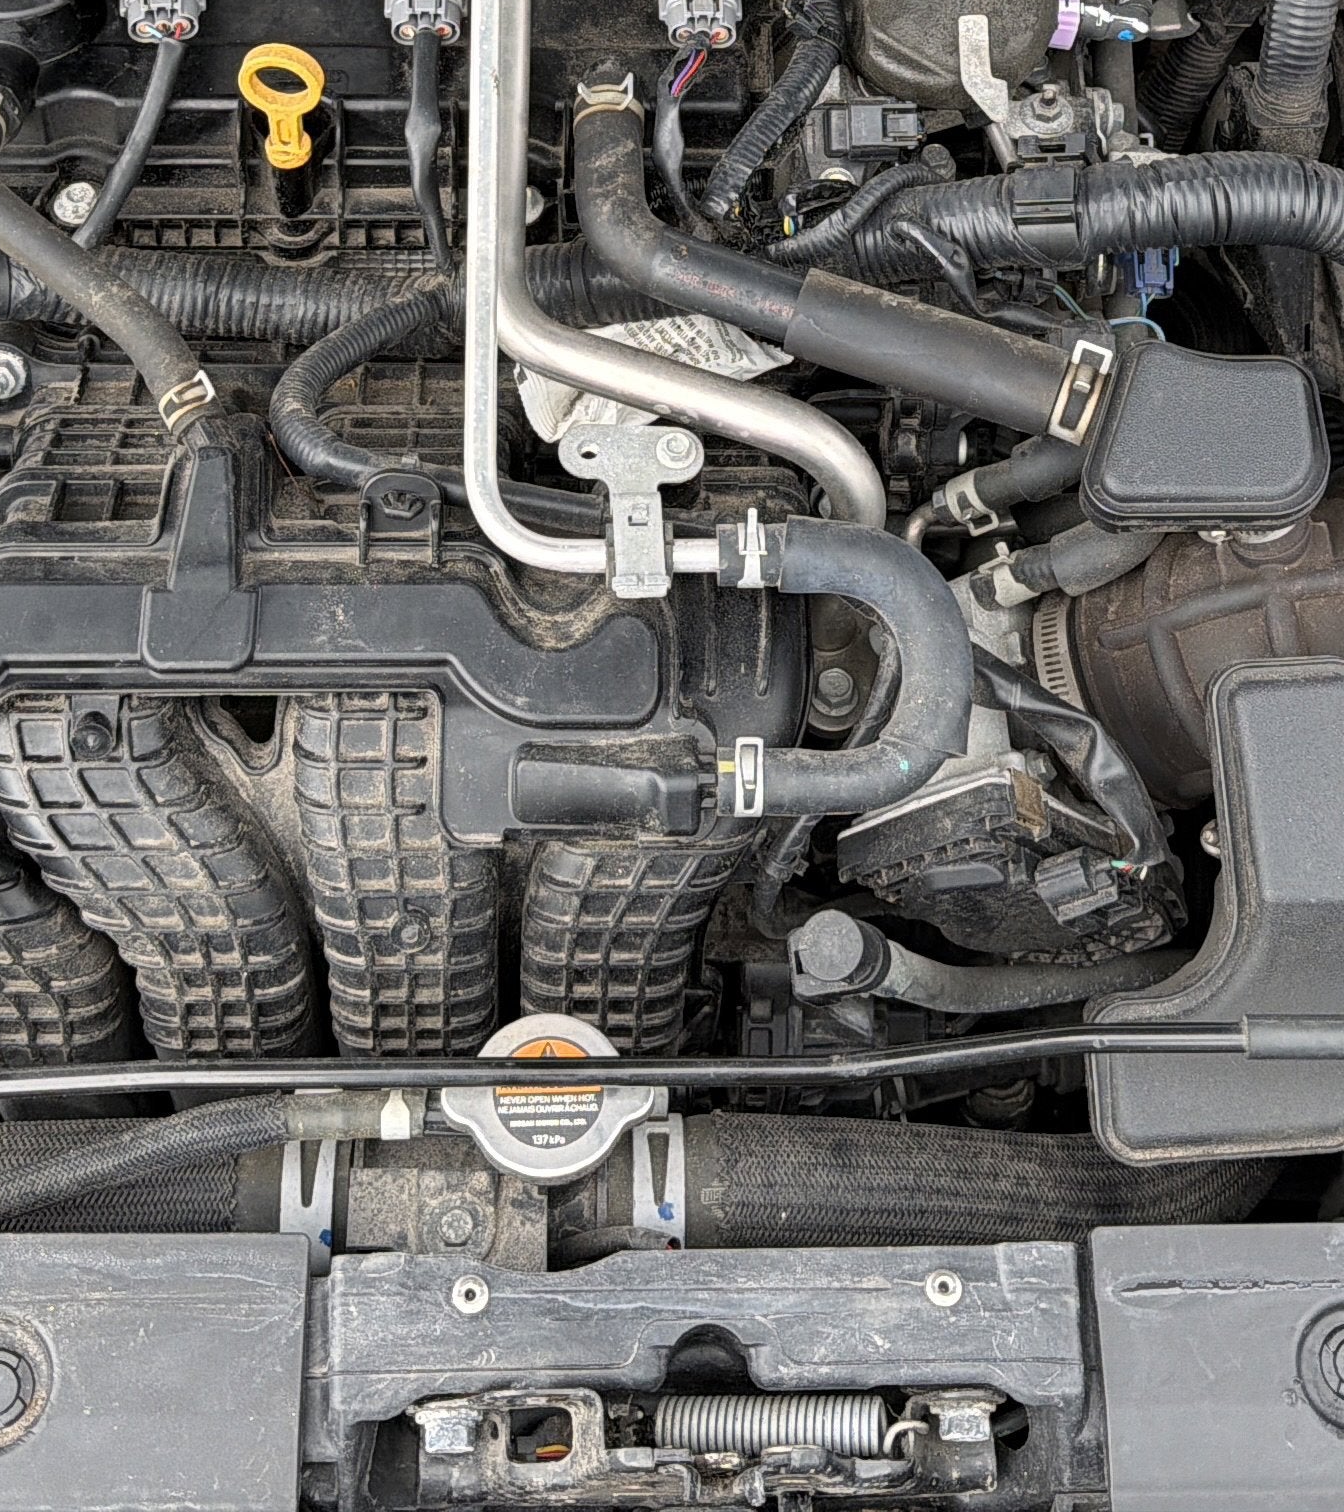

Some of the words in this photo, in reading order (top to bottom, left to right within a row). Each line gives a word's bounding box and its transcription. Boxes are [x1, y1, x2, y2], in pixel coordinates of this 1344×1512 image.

[499, 1095, 527, 1104] NEVER
[527, 1095, 551, 1104] OPEN
[551, 1094, 578, 1103] WHEN
[578, 1093, 597, 1102] HOT.
[497, 1105, 510, 1114] NE
[510, 1105, 536, 1114] JAMAIS
[531, 1134, 548, 1146] 137
[549, 1134, 566, 1145] kPa
